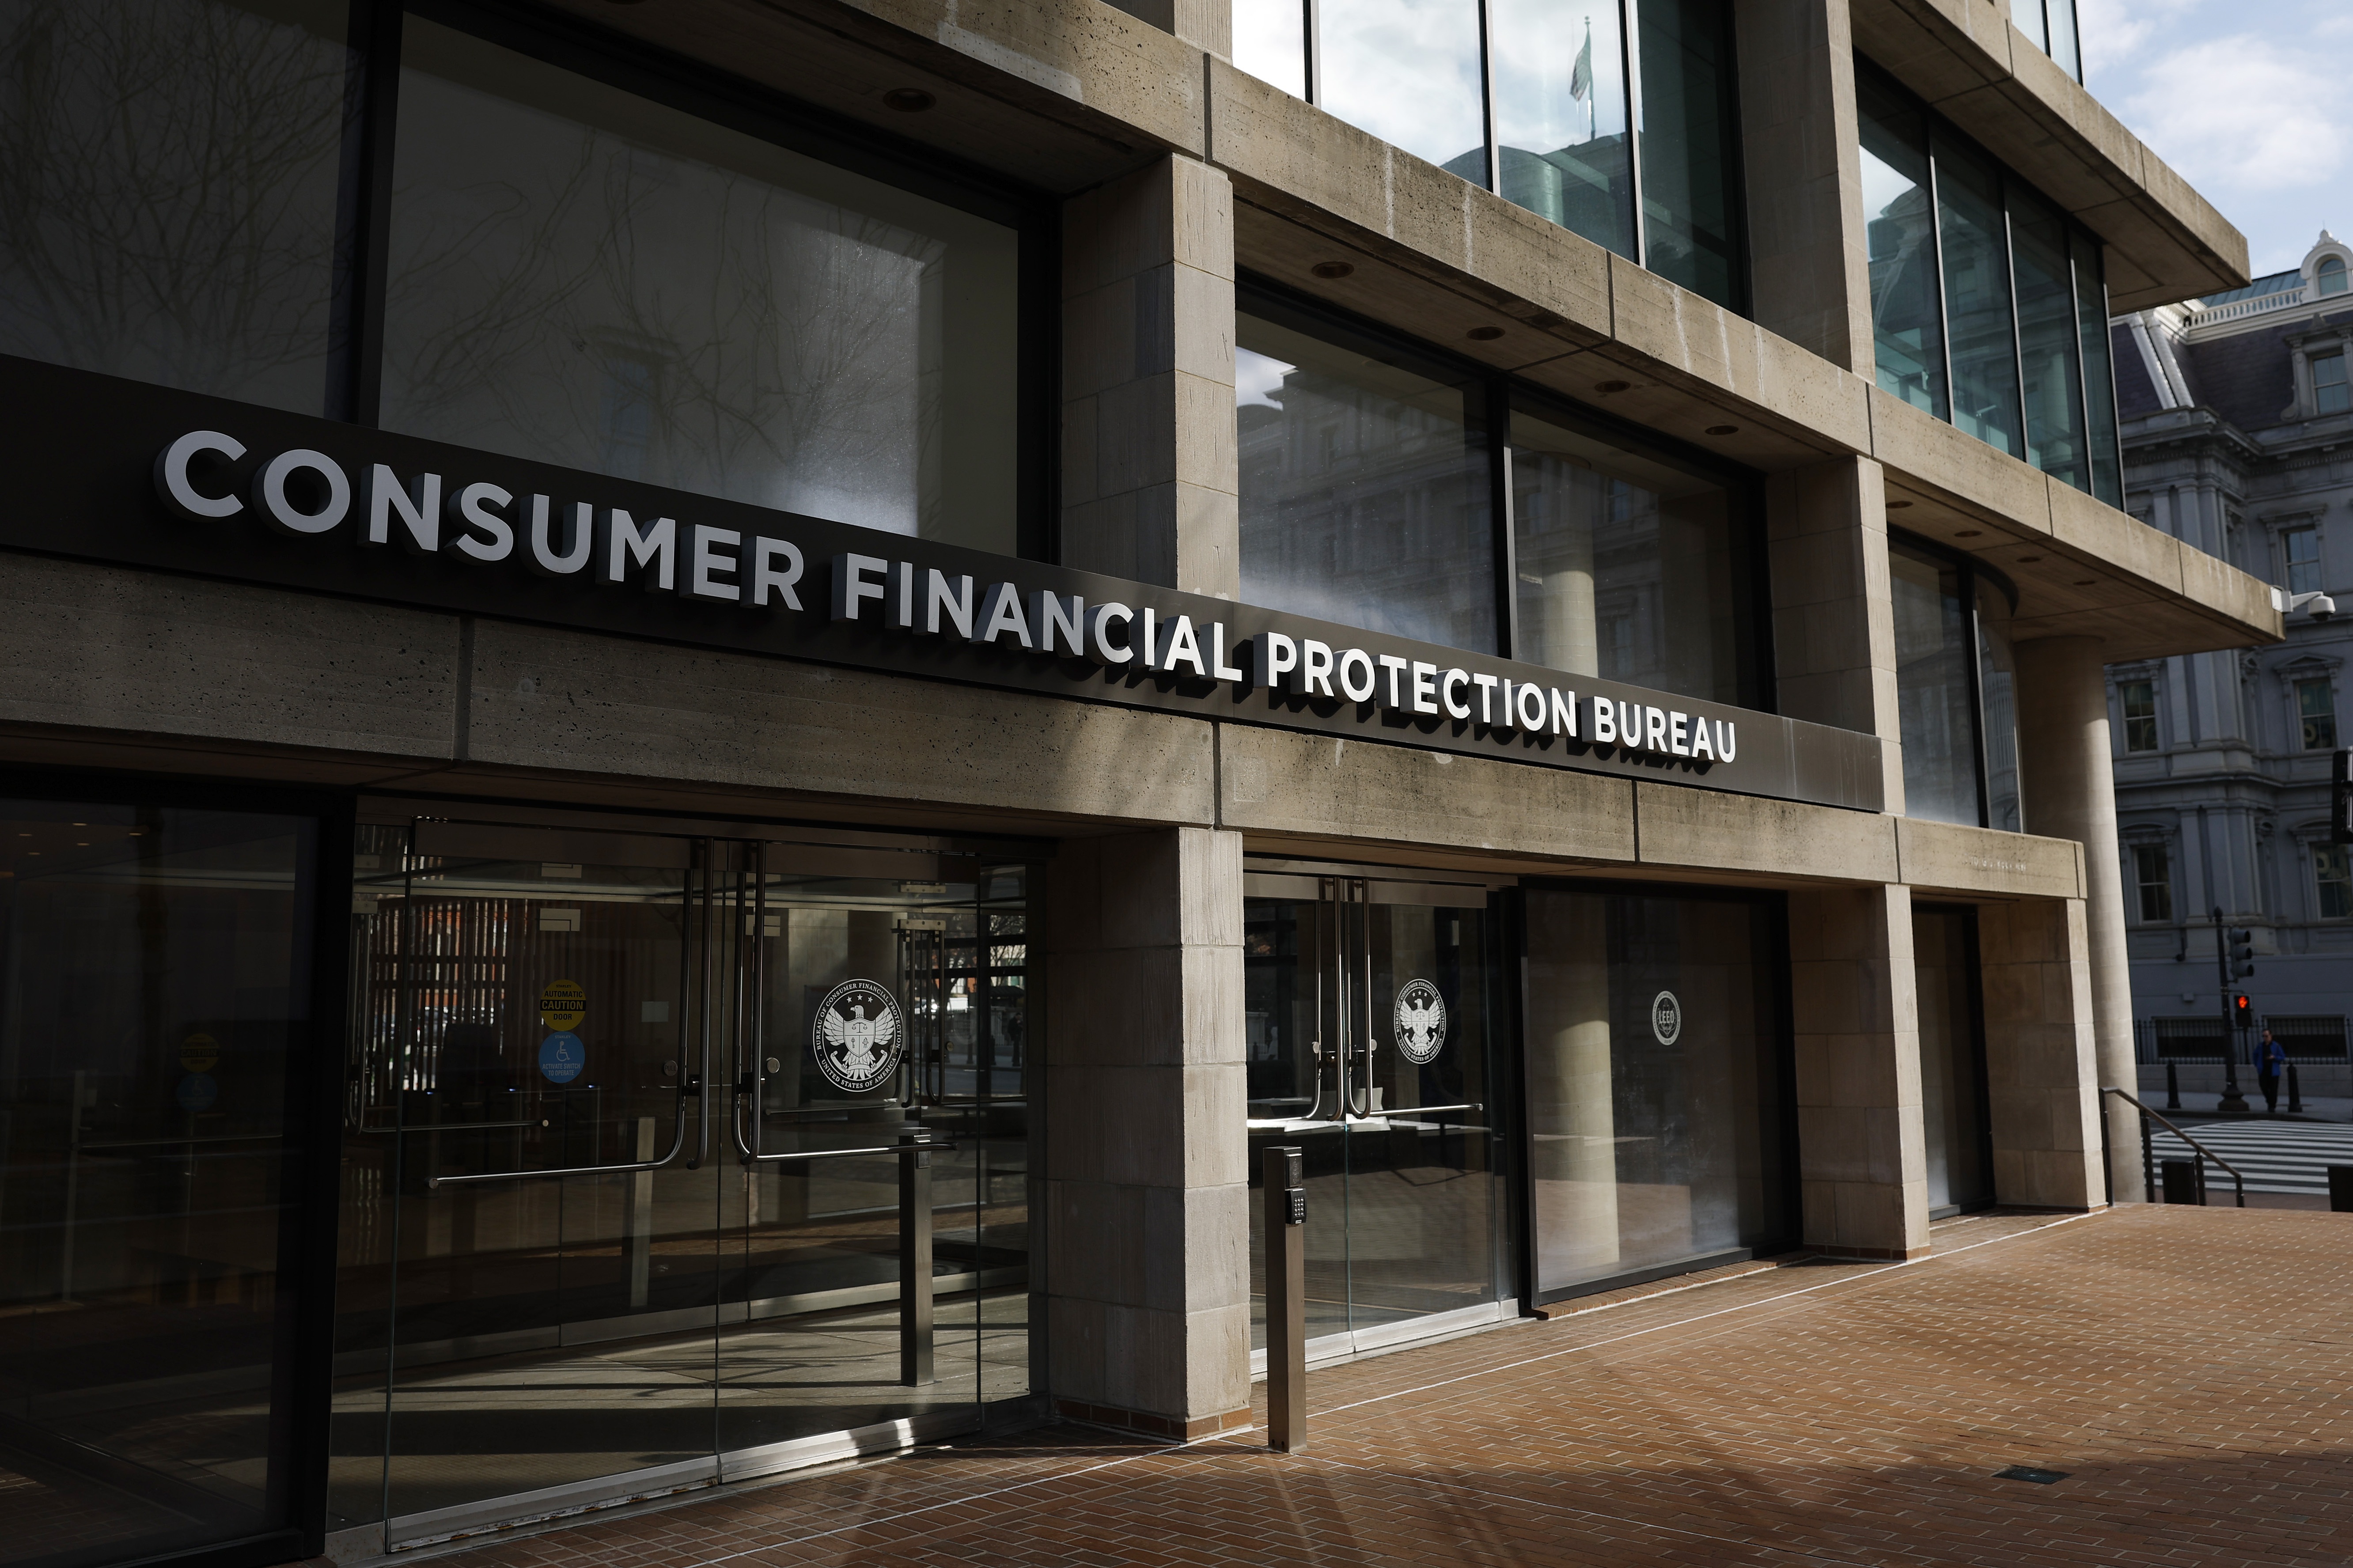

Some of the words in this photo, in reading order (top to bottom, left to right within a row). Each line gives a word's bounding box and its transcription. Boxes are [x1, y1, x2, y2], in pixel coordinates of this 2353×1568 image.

[155, 430, 804, 611] CONSUMER
[832, 553, 1242, 682] FINANCIAL
[1254, 632, 1577, 738] PROTECTION
[1581, 696, 1736, 763] BUREAU
[542, 1000, 584, 1010] CAUTION
[820, 1009, 827, 1018] OF
[826, 983, 857, 1007] CONSUMER
[858, 982, 889, 1002] FINANCIAL
[888, 1001, 902, 1049] PROTECTION
[1400, 981, 1419, 1000] CONSUMER
[1418, 981, 1436, 996] FINANCIAL
[1435, 995, 1445, 1032] PROTECTION
[1658, 1010, 1675, 1024] LEED
[1398, 1038, 1411, 1057] UNITED
[1429, 1038, 1443, 1058] AMERICA
[821, 1058, 840, 1083] UNITED
[841, 1079, 864, 1089] STATES
[875, 1058, 896, 1083] AMERICA
